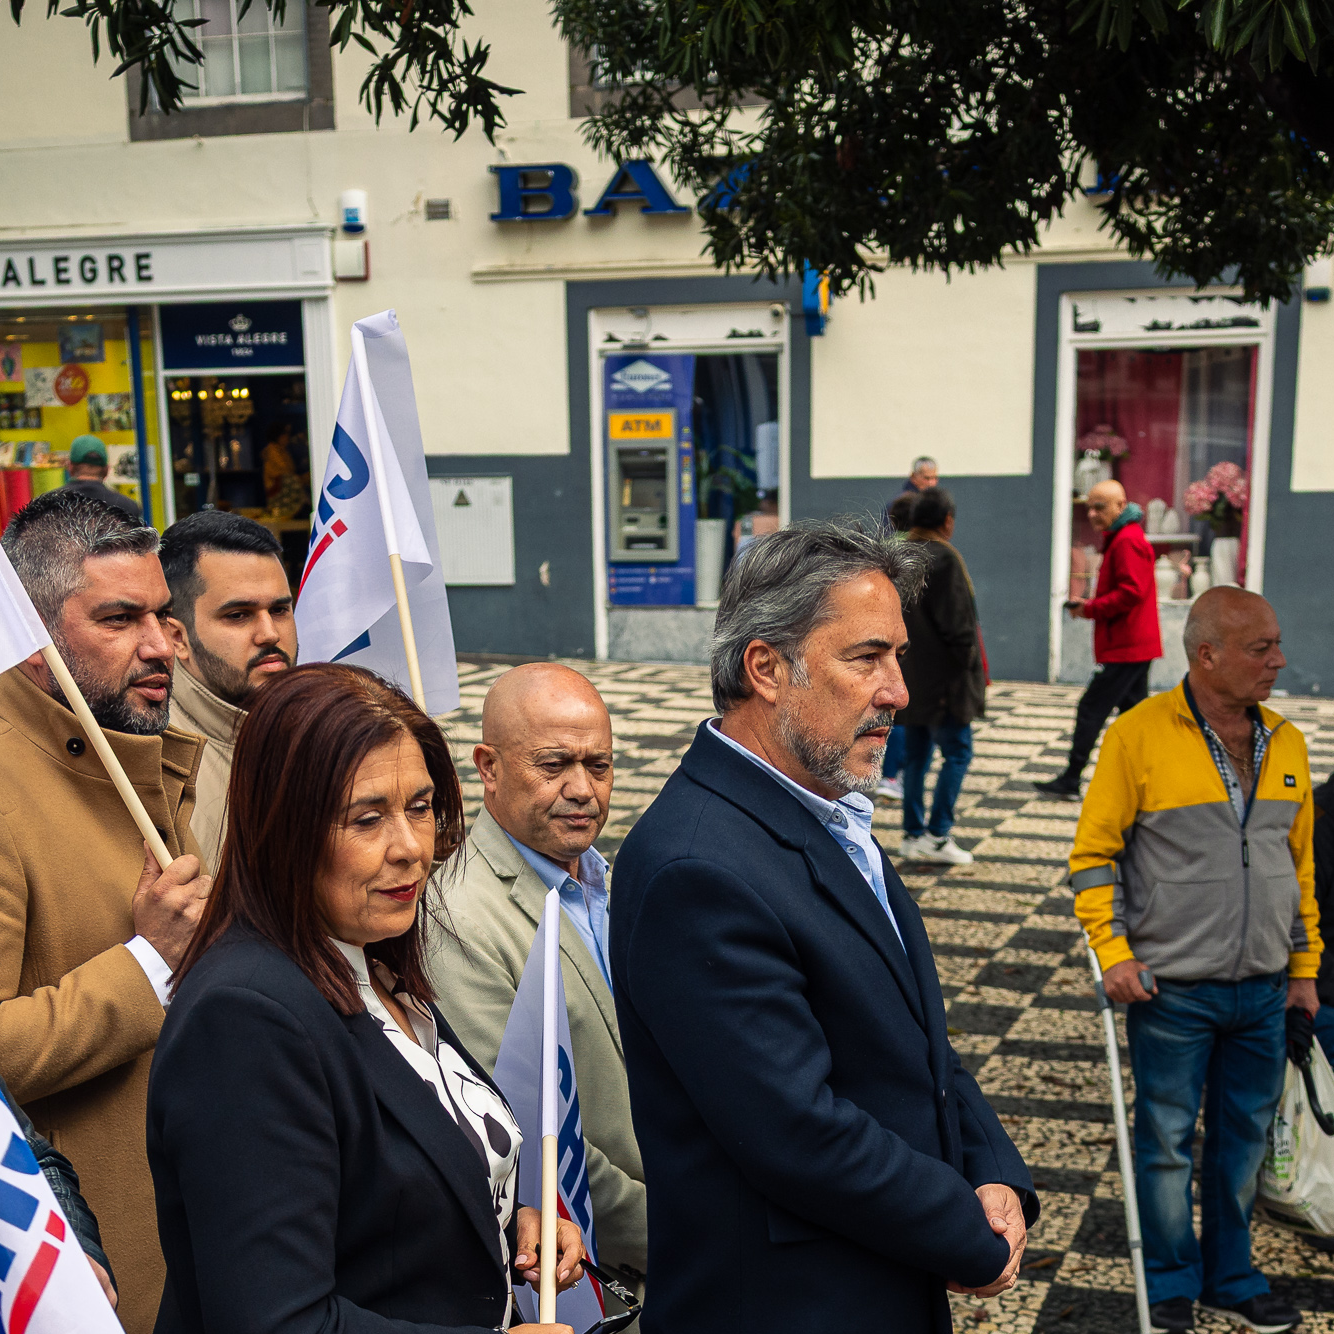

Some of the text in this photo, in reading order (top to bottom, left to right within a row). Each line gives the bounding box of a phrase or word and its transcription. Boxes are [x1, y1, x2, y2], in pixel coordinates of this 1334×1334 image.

[1, 251, 154, 288] ALEGRE
[195, 332, 287, 347] VISTA ALEGRE
[621, 419, 662, 432] ATM
